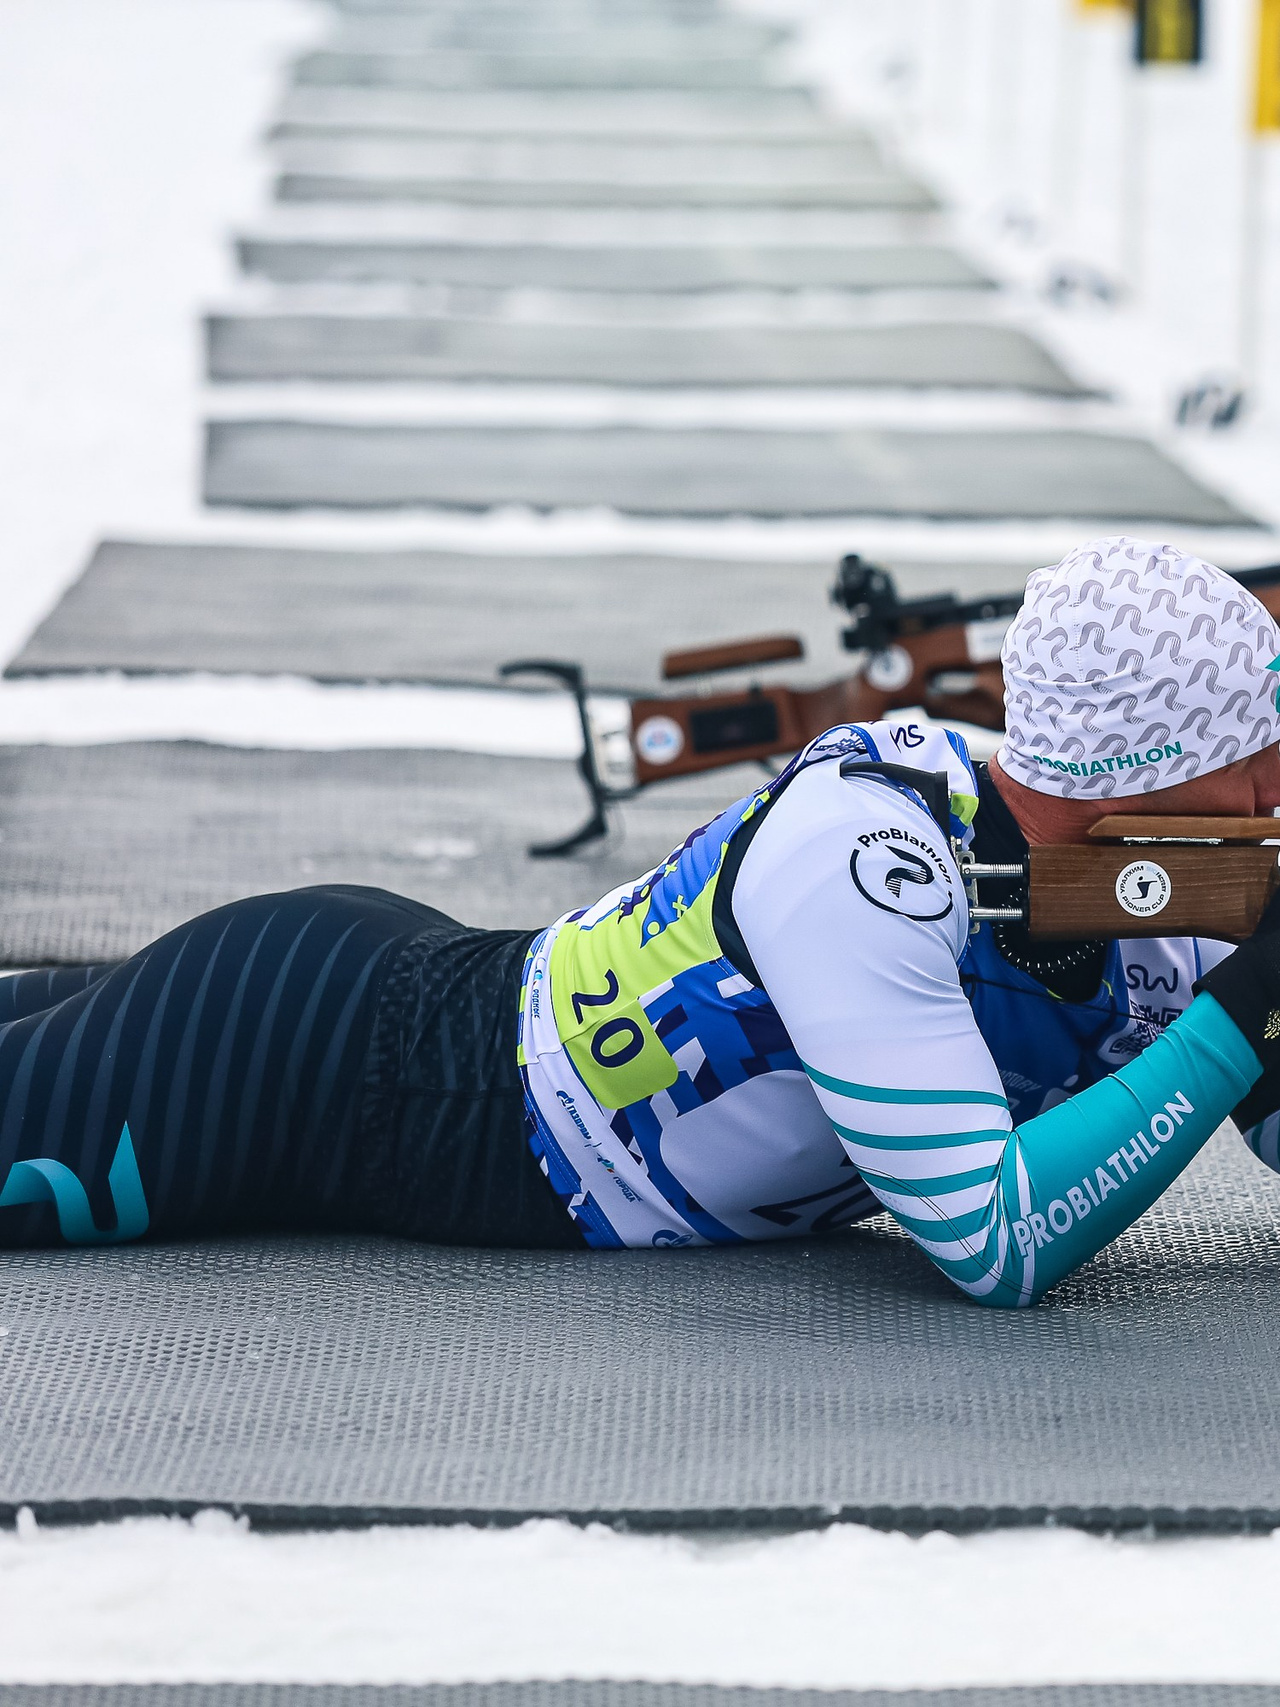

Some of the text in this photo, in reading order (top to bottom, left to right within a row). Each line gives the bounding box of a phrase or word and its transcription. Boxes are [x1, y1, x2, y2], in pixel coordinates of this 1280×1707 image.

[857, 827, 953, 885] ProBiathlon
[1120, 865, 1144, 893] УРАЛХИМ
[1122, 893, 1164, 912] PIONER CUP
[1126, 964, 1178, 993] SW
[571, 968, 645, 1068] 20
[999, 1069, 1042, 1092] ACTORY
[566, 1104, 592, 1140] ГАЗПРОМ
[1012, 1090, 1195, 1257] PROBIATHLON
